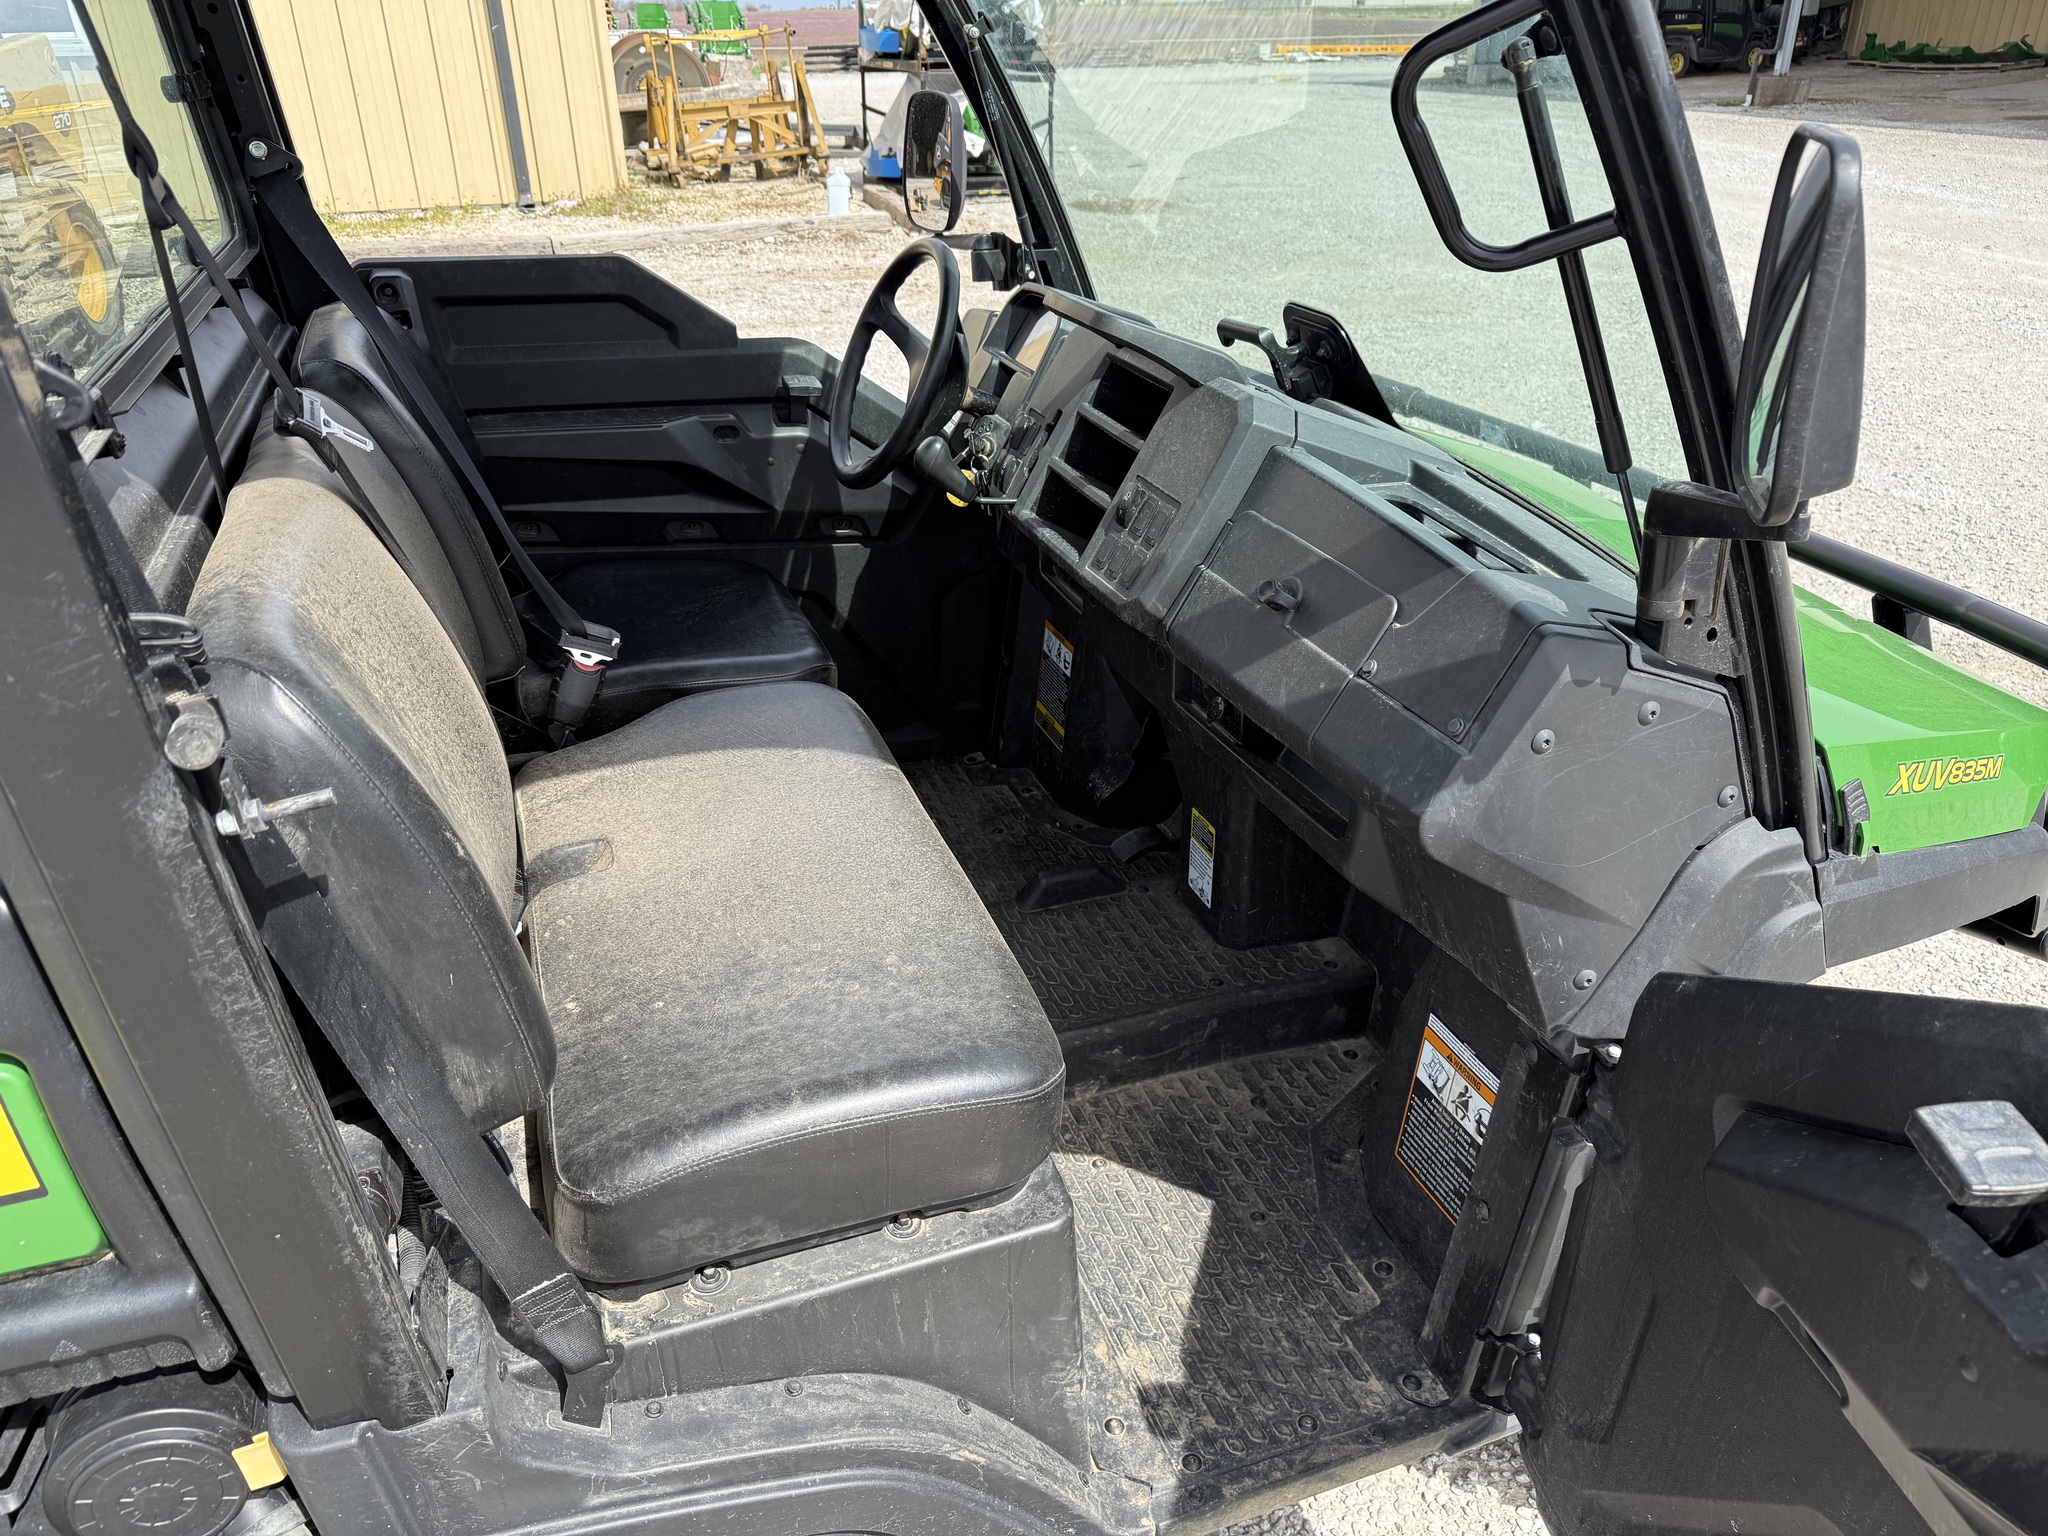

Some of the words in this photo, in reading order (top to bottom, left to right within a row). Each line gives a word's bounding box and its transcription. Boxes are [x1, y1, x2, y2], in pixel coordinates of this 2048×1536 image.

[53, 112, 71, 129] 270
[1884, 754, 2004, 796] XUV835M
[1453, 1058, 1481, 1091] WARNING
